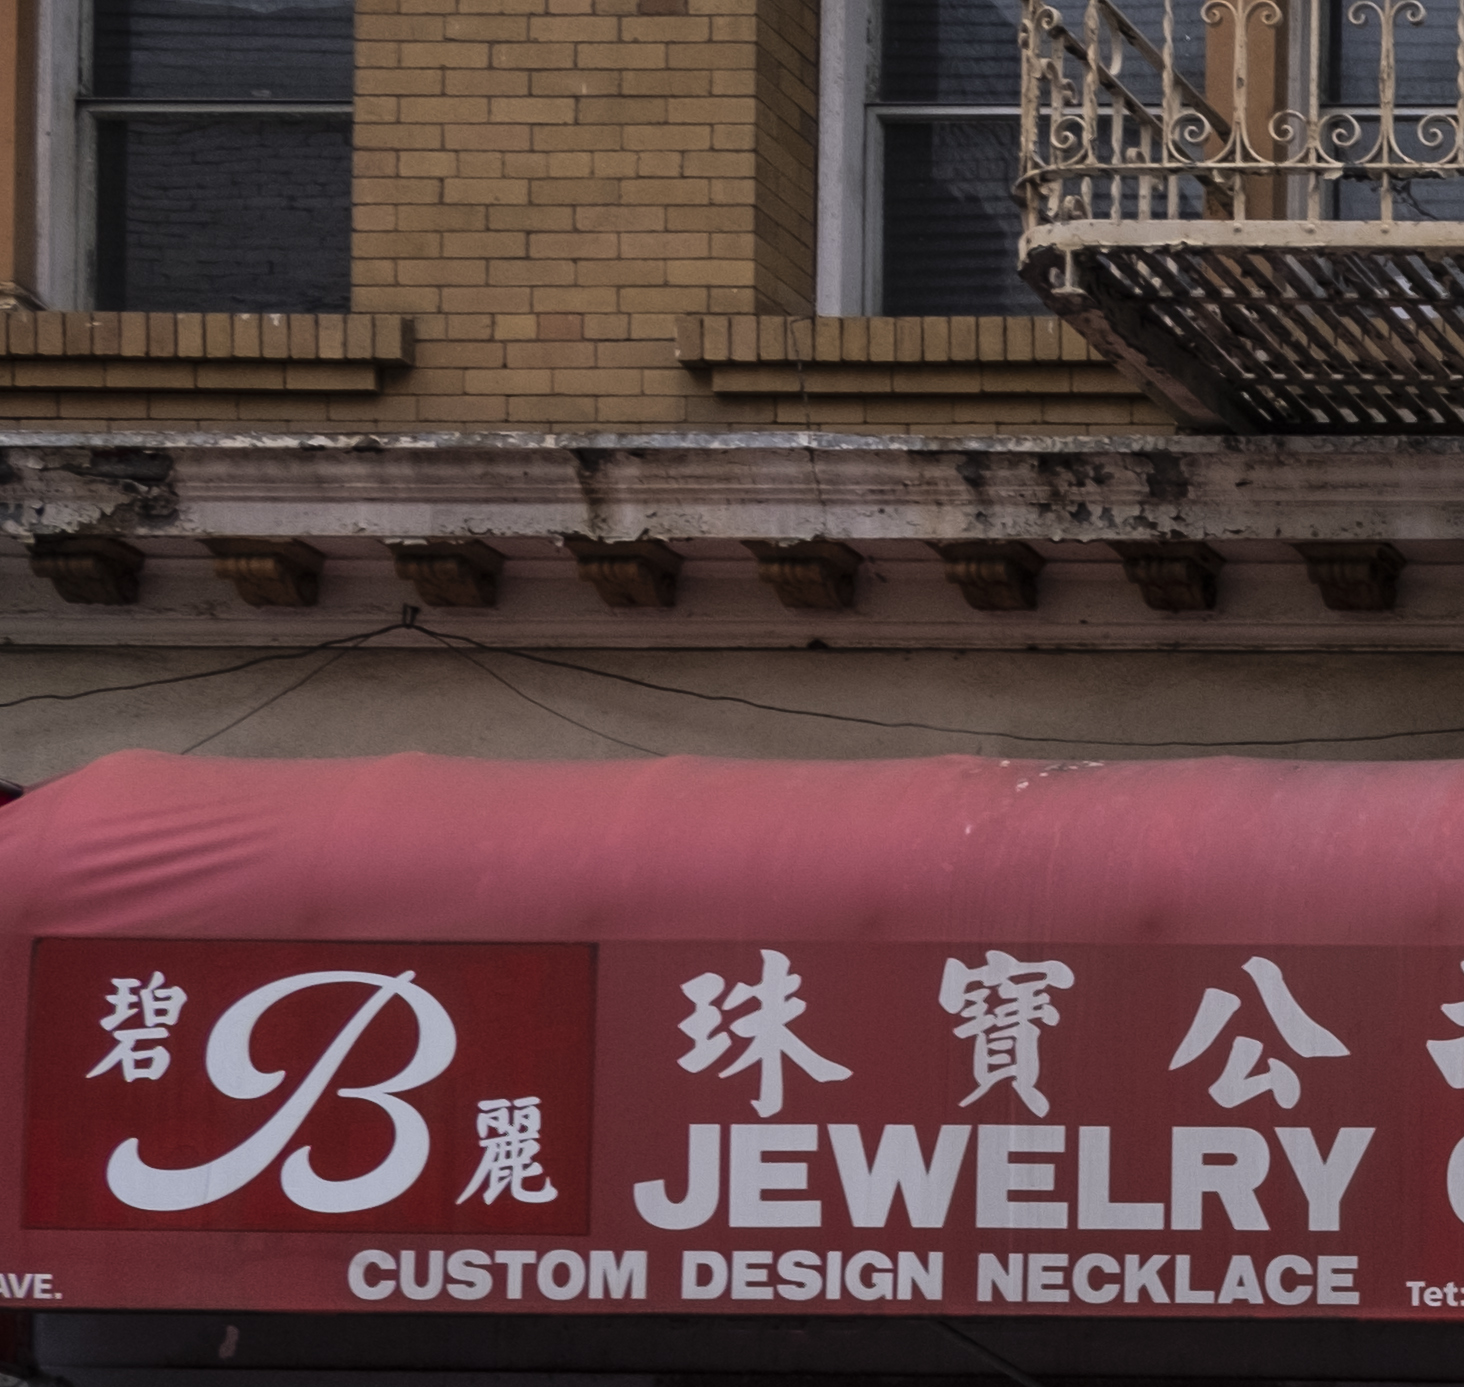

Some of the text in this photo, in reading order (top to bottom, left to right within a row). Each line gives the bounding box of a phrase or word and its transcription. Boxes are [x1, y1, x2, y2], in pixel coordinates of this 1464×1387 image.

[86, 971, 187, 1082] 碧
[106, 970, 457, 1213] B
[456, 1097, 558, 1205] 麗
[634, 1124, 1375, 1231] JEWELRY
[348, 1250, 1359, 1305] CUSTOM DESIGN NECKLACE
